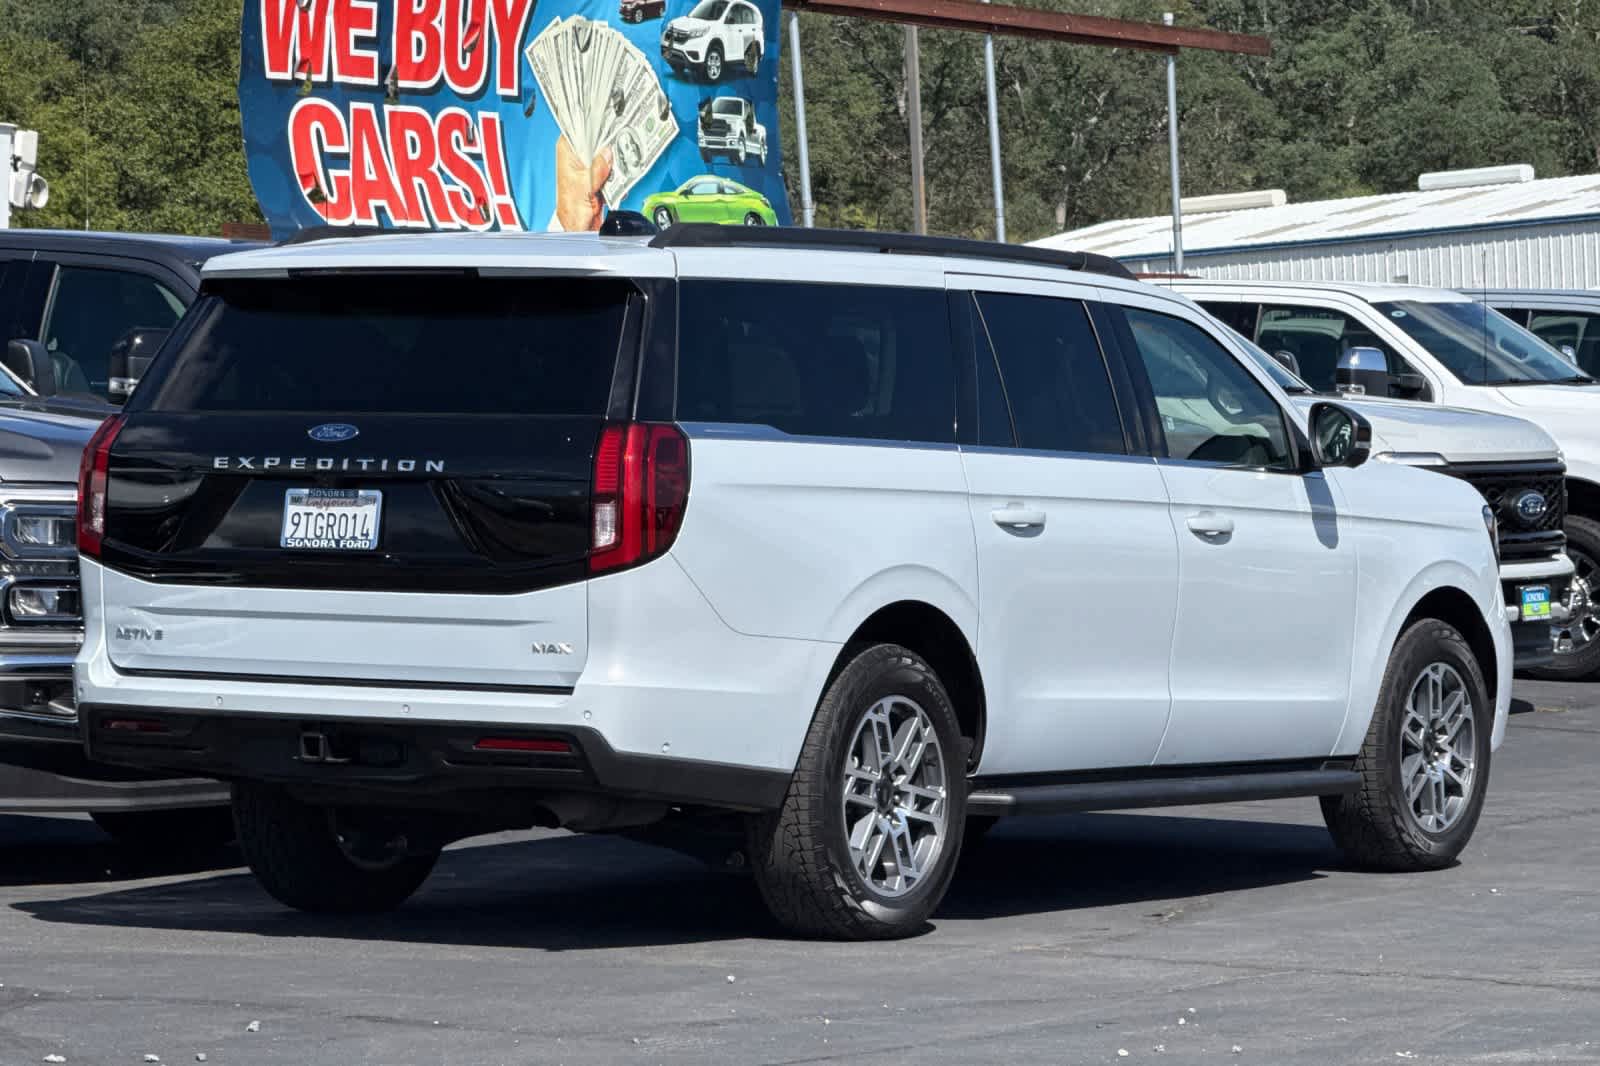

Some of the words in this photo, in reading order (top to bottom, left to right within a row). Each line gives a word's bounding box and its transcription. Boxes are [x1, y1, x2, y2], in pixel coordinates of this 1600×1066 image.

[261, 0, 380, 86] WE
[394, 0, 531, 97] BUY
[288, 97, 524, 232] CARS!
[213, 456, 445, 473] EXPEDITION
[290, 512, 370, 539] 9TGR014
[286, 538, 336, 548] SONORA
[339, 539, 370, 549] FORD
[531, 643, 573, 655] MAX
